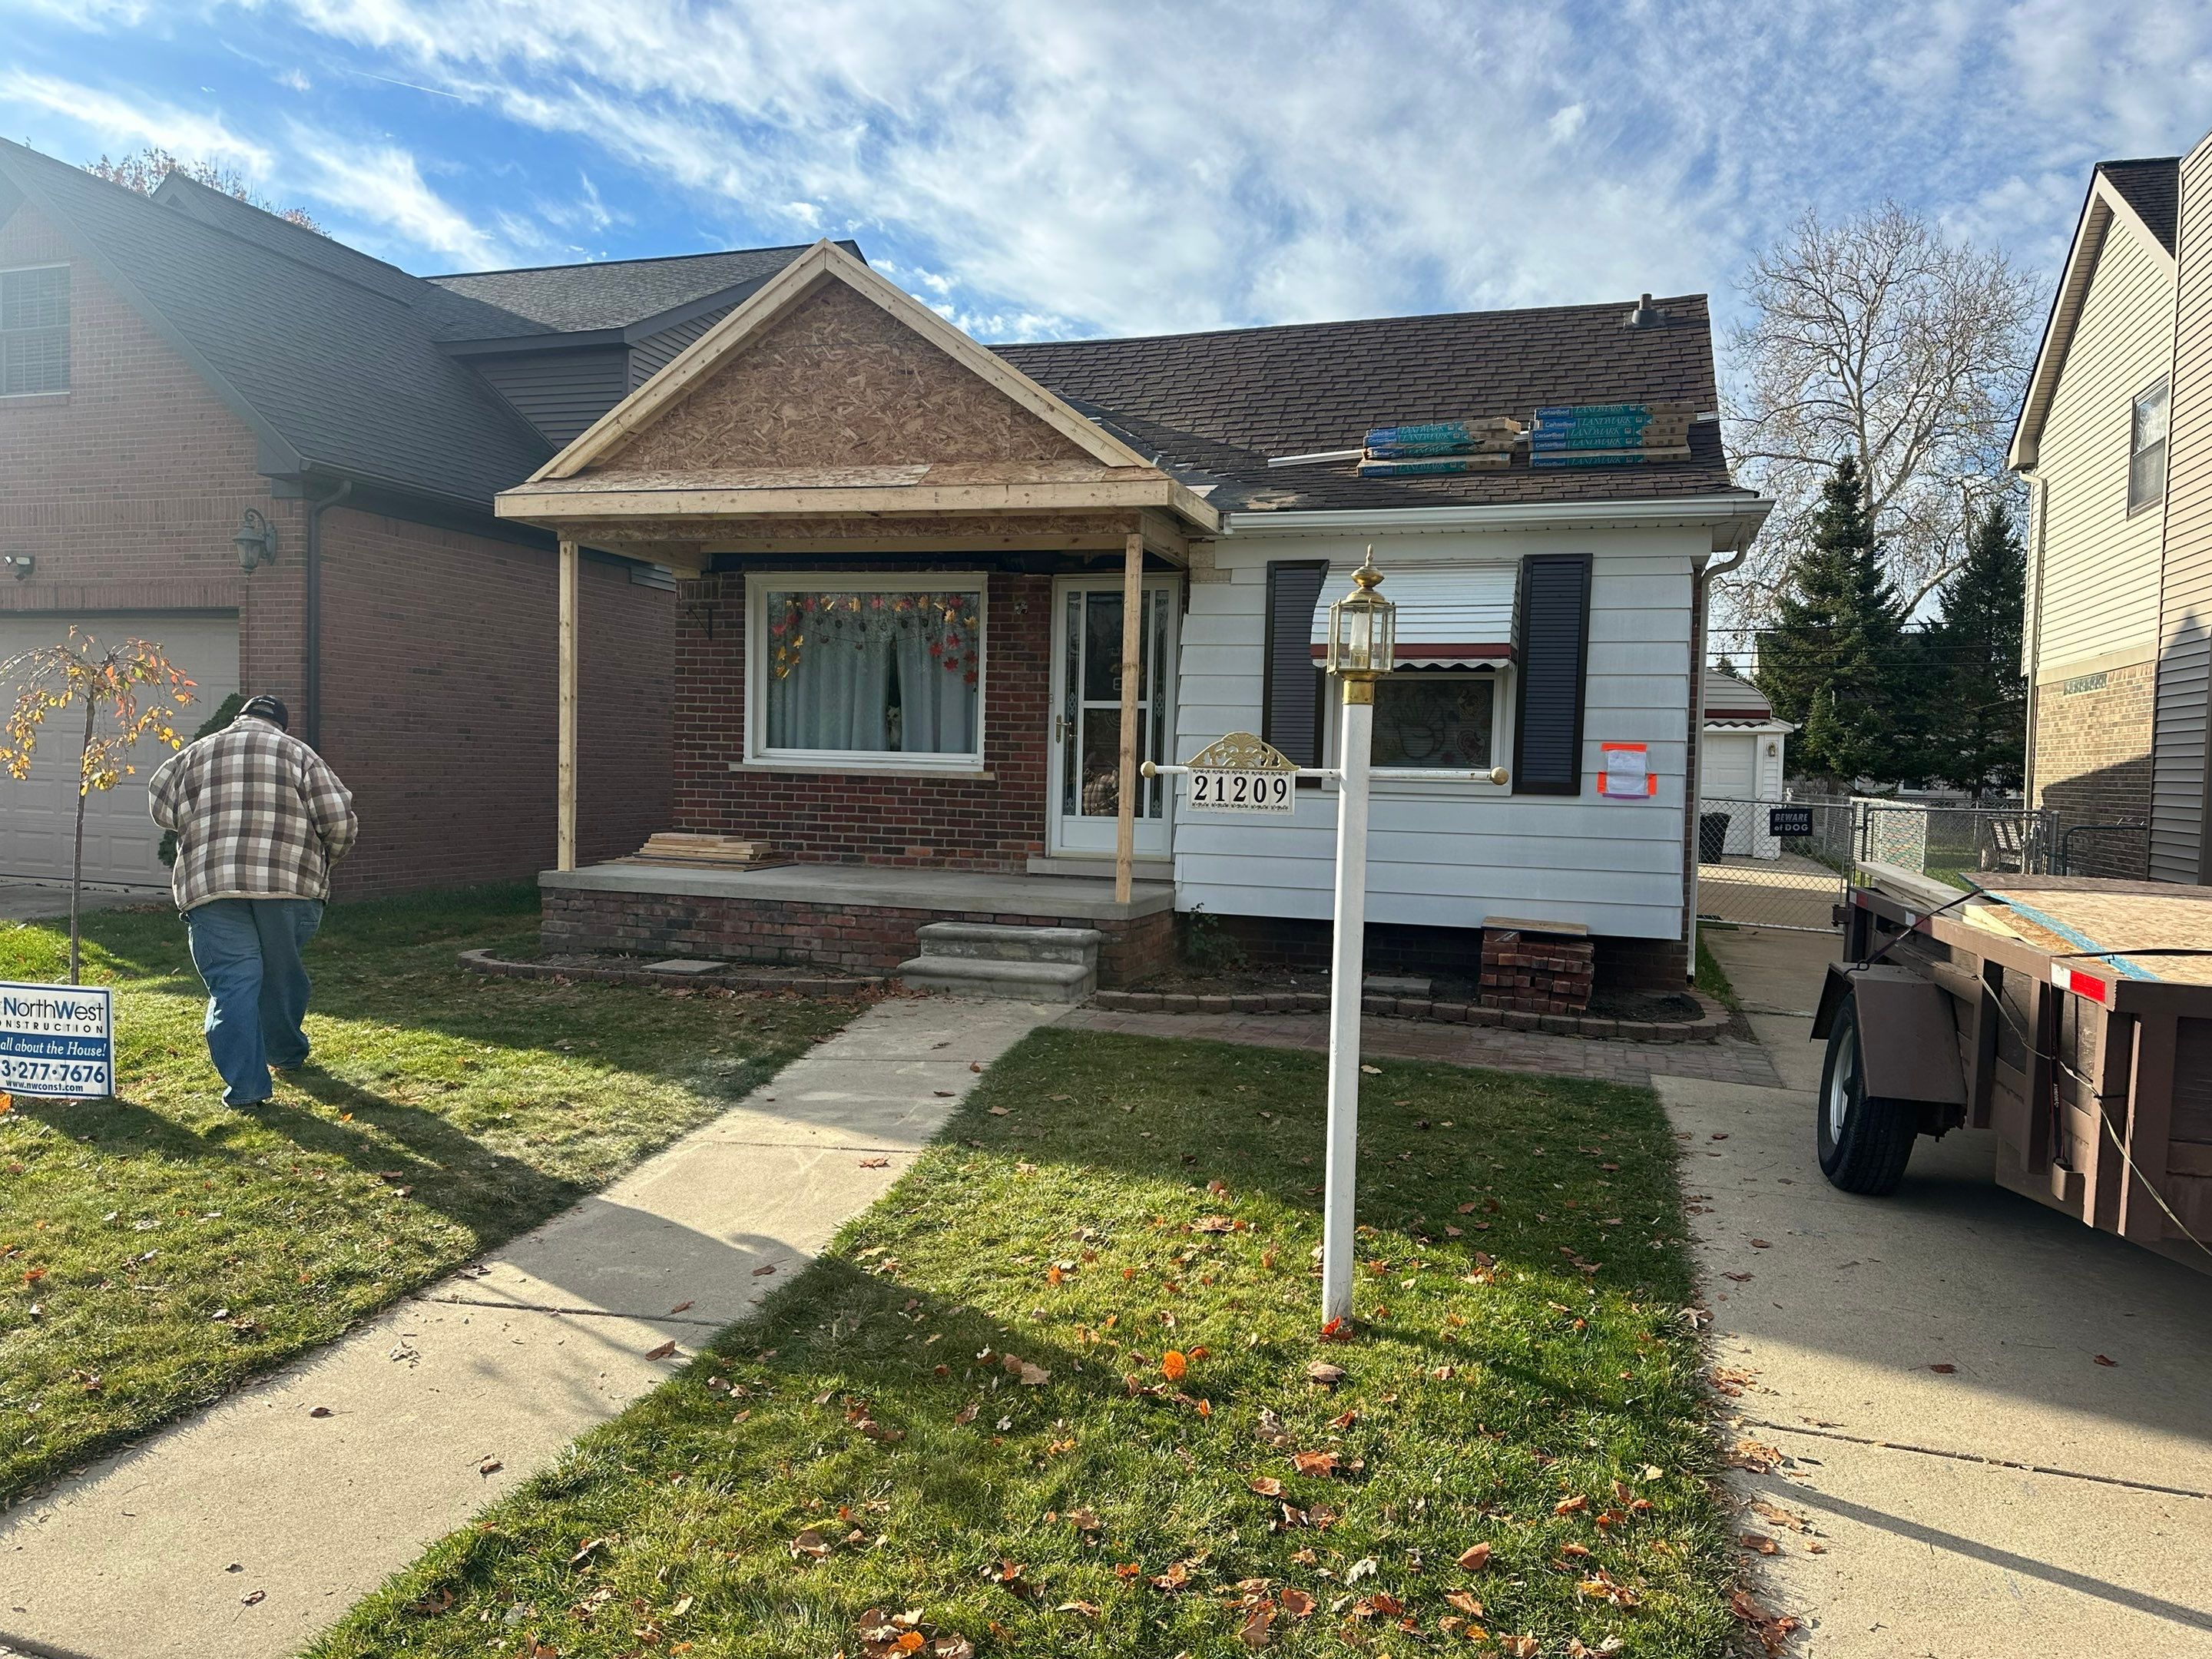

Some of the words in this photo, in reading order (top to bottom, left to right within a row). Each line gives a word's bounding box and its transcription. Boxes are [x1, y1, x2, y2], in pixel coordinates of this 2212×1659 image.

[1582, 416, 1631, 426] LANDMARK
[1571, 426, 1620, 435] LANDMARK
[1402, 432, 1449, 441] LANDMARK
[1572, 437, 1621, 446] LANDMARK
[1571, 456, 1621, 465] LANDMARK
[1194, 775, 1287, 803] 21209
[4, 997, 104, 1021] NorthWest
[0, 1020, 103, 1033] NSTRUCTION
[15, 1038, 44, 1053] about
[46, 1041, 64, 1055] the
[67, 1041, 107, 1056] House!
[6, 1080, 83, 1092] www.nwconst.com
